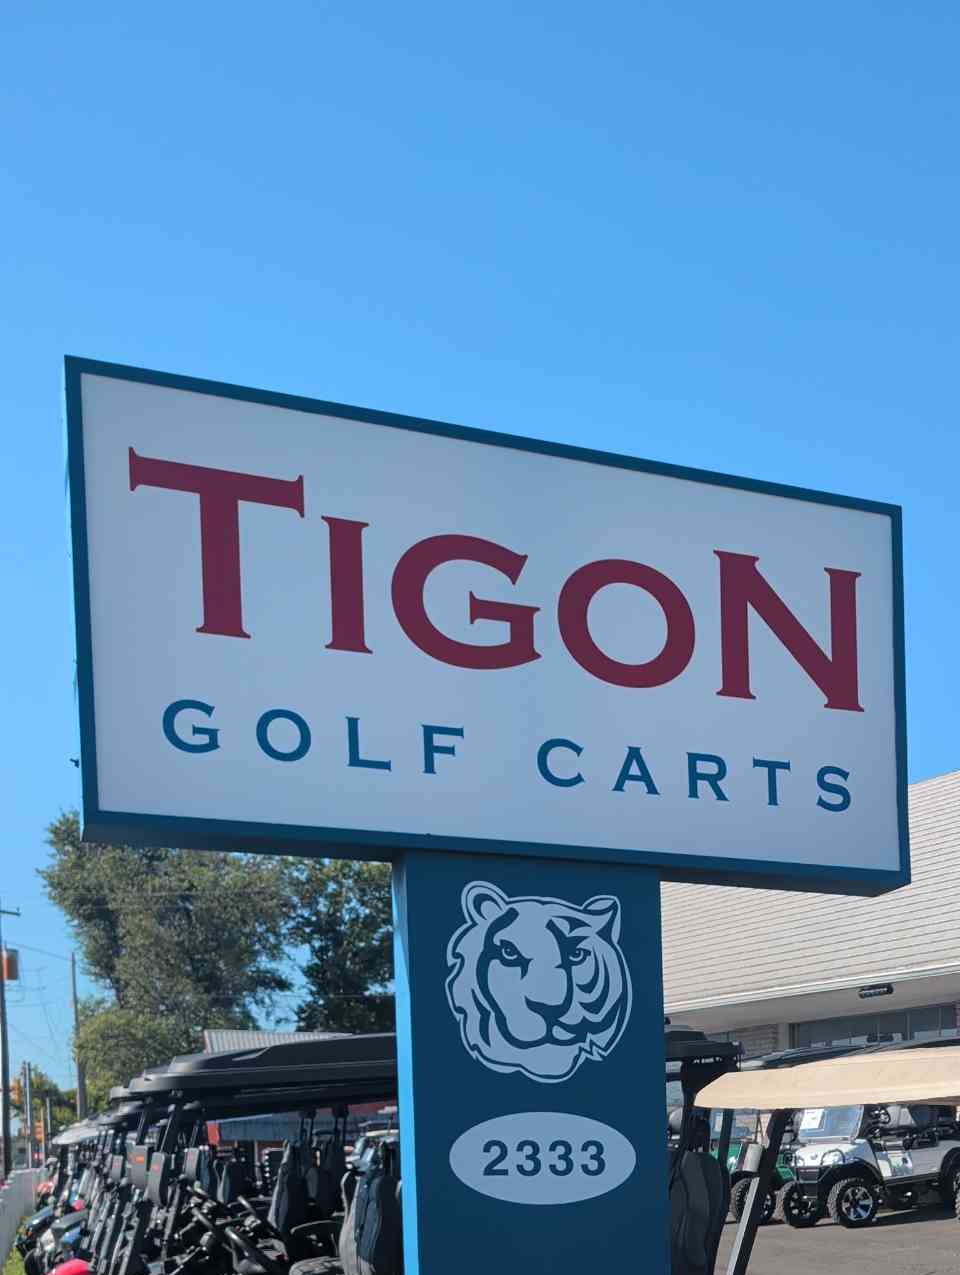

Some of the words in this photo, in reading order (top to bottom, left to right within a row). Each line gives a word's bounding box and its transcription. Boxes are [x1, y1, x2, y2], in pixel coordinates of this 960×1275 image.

[128, 446, 865, 713] TIGON
[162, 698, 466, 775] GOLF
[536, 738, 853, 813] CARTS
[482, 1139, 606, 1177] 2333
